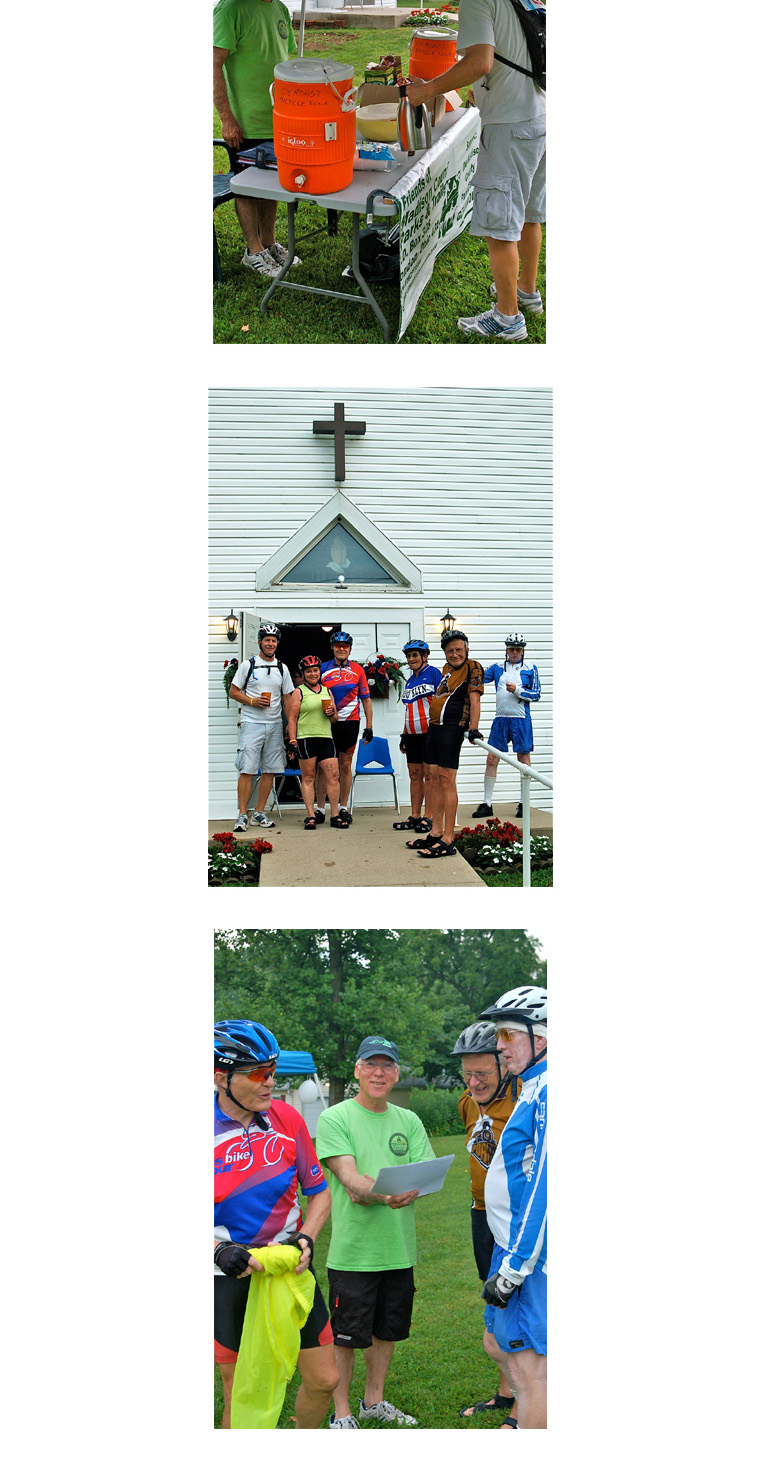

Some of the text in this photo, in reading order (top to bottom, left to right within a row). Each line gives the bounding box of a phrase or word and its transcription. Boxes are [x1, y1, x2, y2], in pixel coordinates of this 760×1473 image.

[294, 88, 320, 97] ROAST
[279, 96, 305, 107] BICYCLE
[287, 136, 306, 147] igloo
[400, 166, 432, 211] Friends of
[225, 1150, 250, 1163] bike
